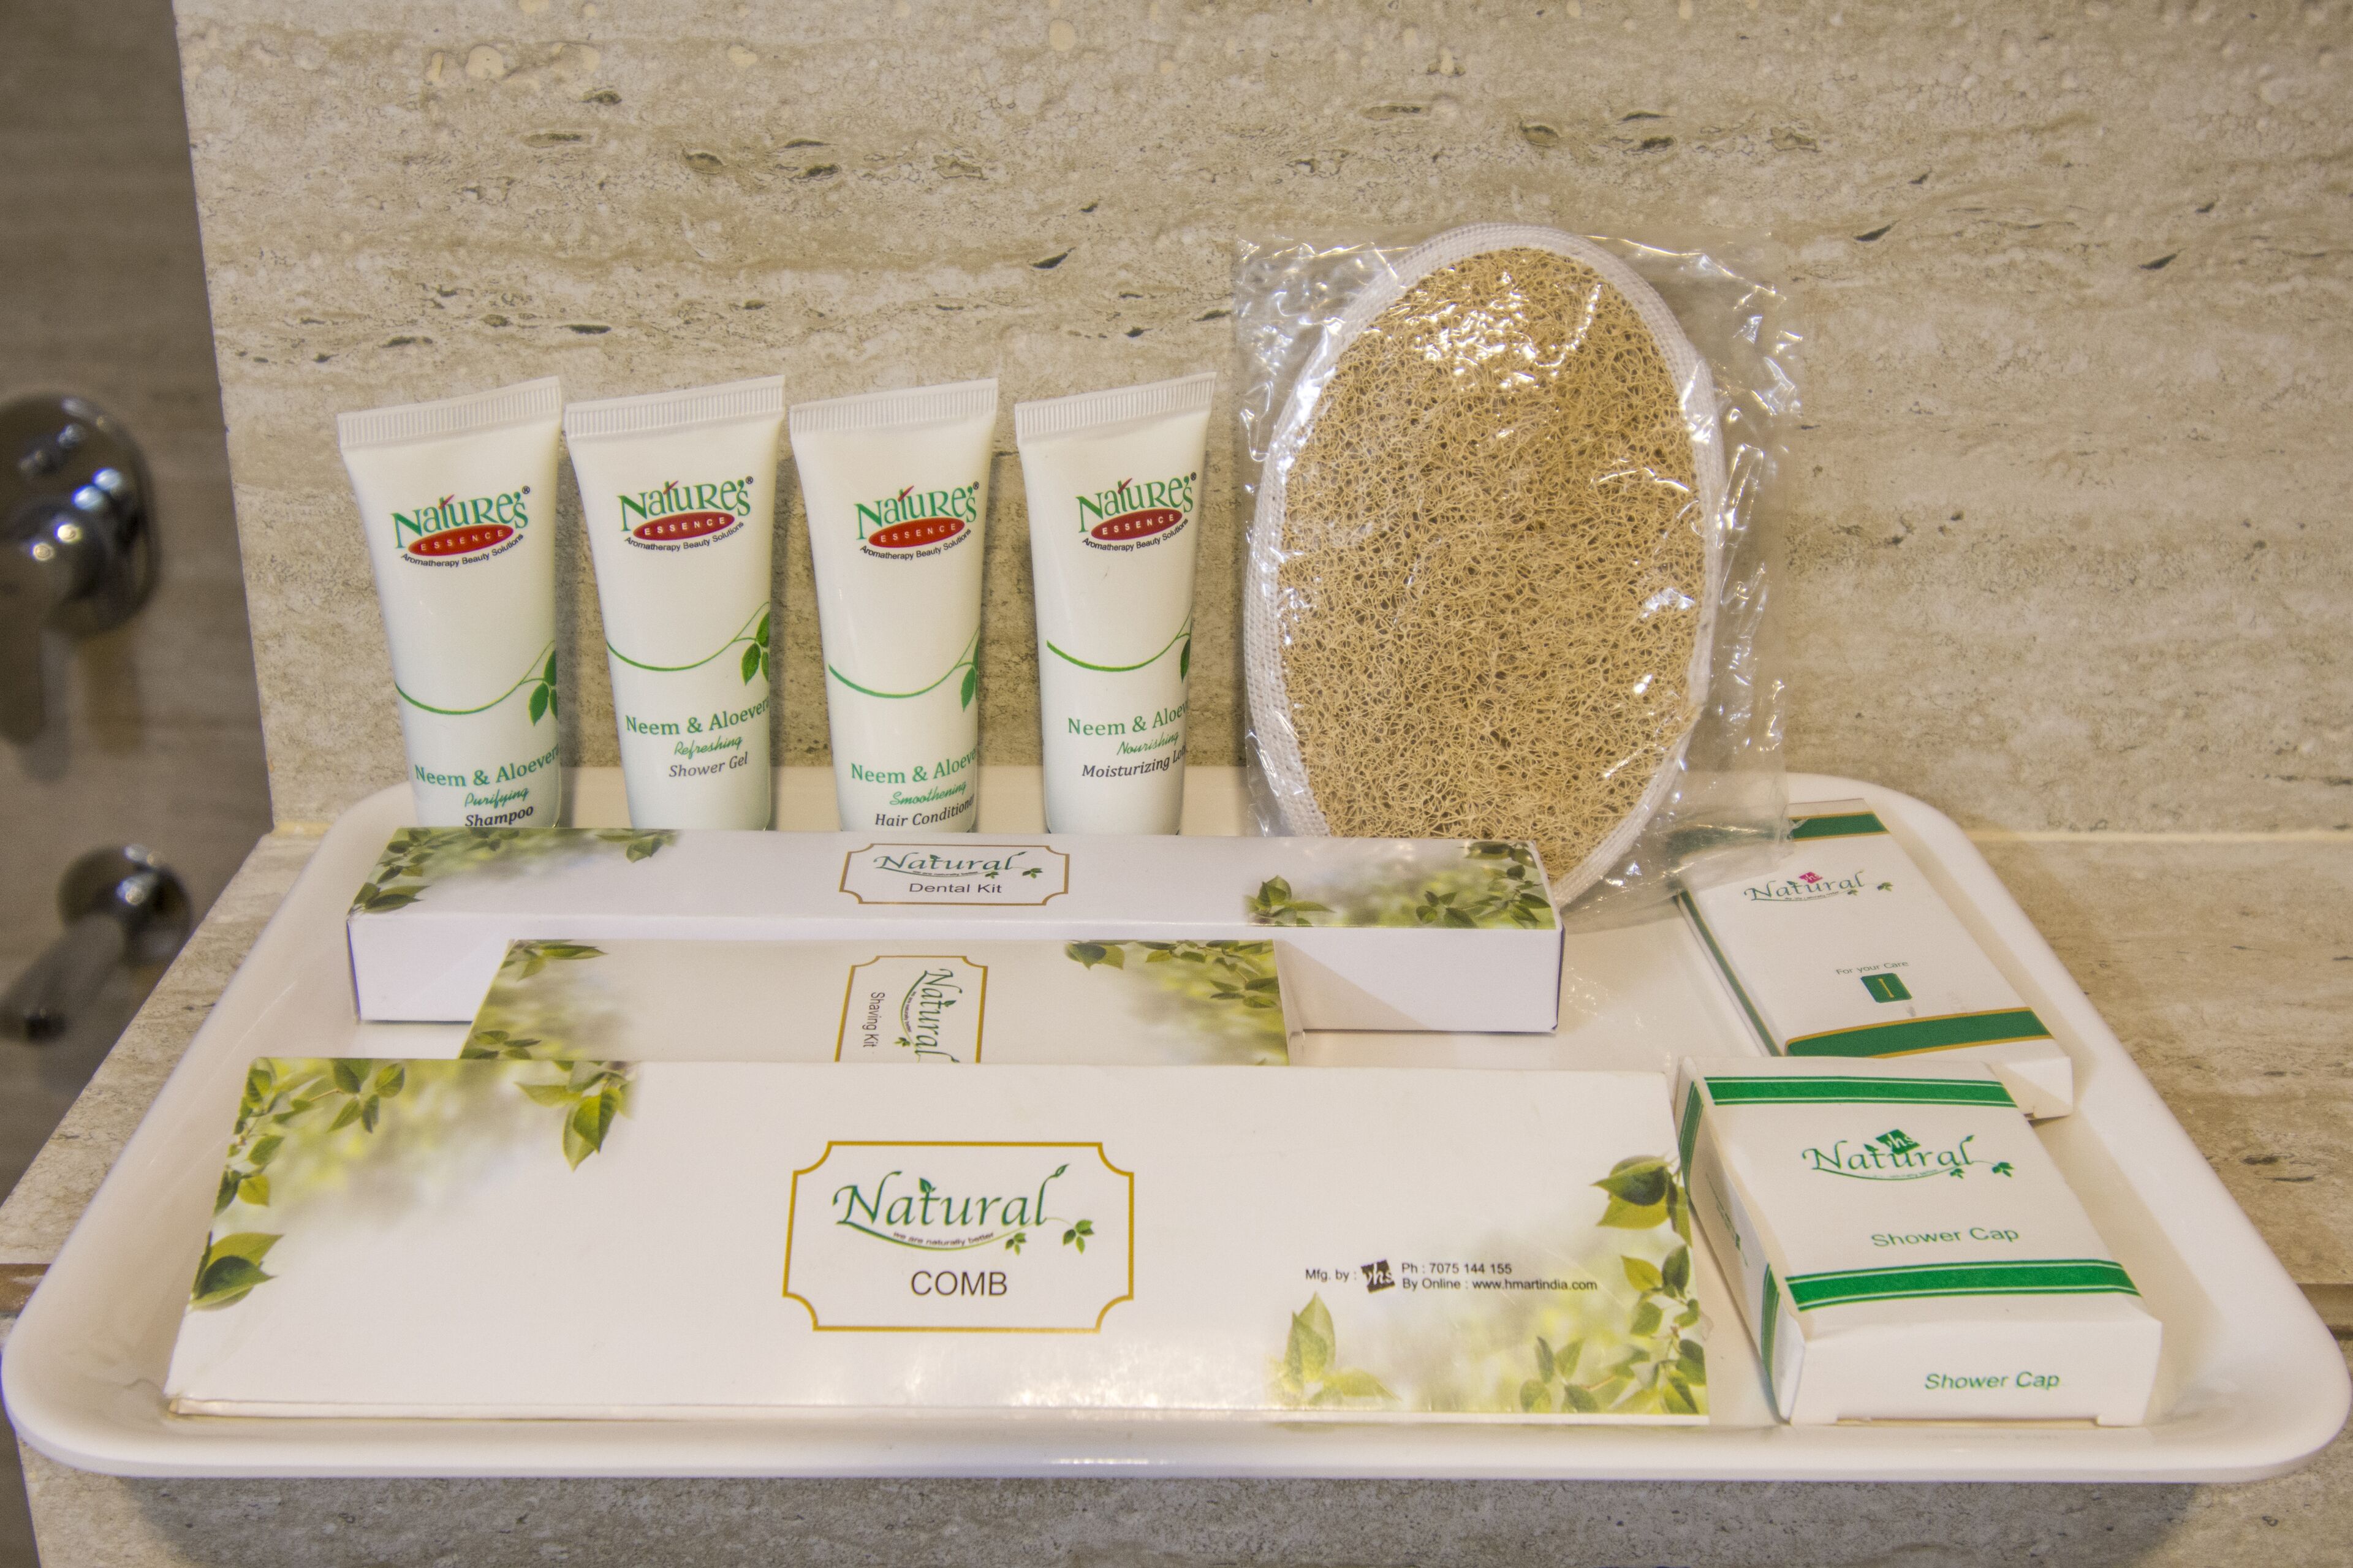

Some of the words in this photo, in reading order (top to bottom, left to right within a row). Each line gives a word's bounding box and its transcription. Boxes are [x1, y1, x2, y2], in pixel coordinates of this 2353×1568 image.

[643, 517, 726, 536] ESSENCE
[880, 523, 957, 543] ESSENCE
[1082, 537, 1134, 552] Aromatherapy
[1136, 537, 1161, 549] Beauty
[1162, 518, 1188, 541] Solutions
[1102, 513, 1175, 536] ESSENCE
[420, 529, 504, 551] ESSENCE
[624, 537, 681, 552] Aromatherapy
[683, 539, 710, 550] Beauty
[713, 521, 745, 543] Solutions
[860, 545, 914, 561] Aromatherapy
[915, 547, 942, 558] Beauty
[943, 528, 971, 551] Solutions
[401, 553, 460, 568] Aromatherapy
[462, 553, 490, 565] Beauty
[491, 532, 524, 556] Solutions
[625, 715, 681, 735] Neem
[687, 717, 703, 733] &
[1068, 717, 1126, 735] Neem
[1132, 715, 1148, 733] &
[674, 735, 743, 760] Refreshing
[1116, 732, 1180, 756] Nourishing
[414, 764, 468, 787] Neem
[472, 770, 490, 786] &
[669, 762, 726, 778] Shower
[729, 751, 748, 769] Gel
[851, 762, 906, 784] Neem
[912, 765, 928, 782] &
[1082, 756, 1170, 778] Moisturizing
[464, 787, 529, 809] Purifying
[889, 781, 967, 805] Smoothening
[464, 806, 534, 827] Shampoo
[874, 813, 909, 827] Hair
[873, 851, 1028, 871] Natural
[909, 883, 970, 893] Dental
[977, 884, 1002, 893] Kit
[1743, 870, 1866, 901] Natural
[1857, 964, 1881, 974] your
[862, 991, 885, 1031] Shaving
[915, 969, 963, 1063] Natural
[863, 1034, 879, 1048] Kit
[1802, 1135, 1976, 1170] Natural
[833, 1164, 1070, 1226] Natural
[1871, 1232, 1961, 1248] Shower
[1969, 1227, 2020, 1243] Cap
[1305, 1268, 1331, 1283] Mfg.
[1335, 1268, 1350, 1282] by
[1401, 1262, 1418, 1274] Ph
[1430, 1262, 1460, 1274] 7075
[1464, 1263, 1485, 1274] 144
[1490, 1263, 1513, 1274] 155
[911, 1270, 1008, 1297] COMB
[1402, 1278, 1418, 1292] By
[1422, 1278, 1461, 1290] Online
[1472, 1278, 1598, 1291] www.hmartindia.com
[1925, 1373, 2009, 1390] Shower
[2015, 1371, 2060, 1390] Cap
